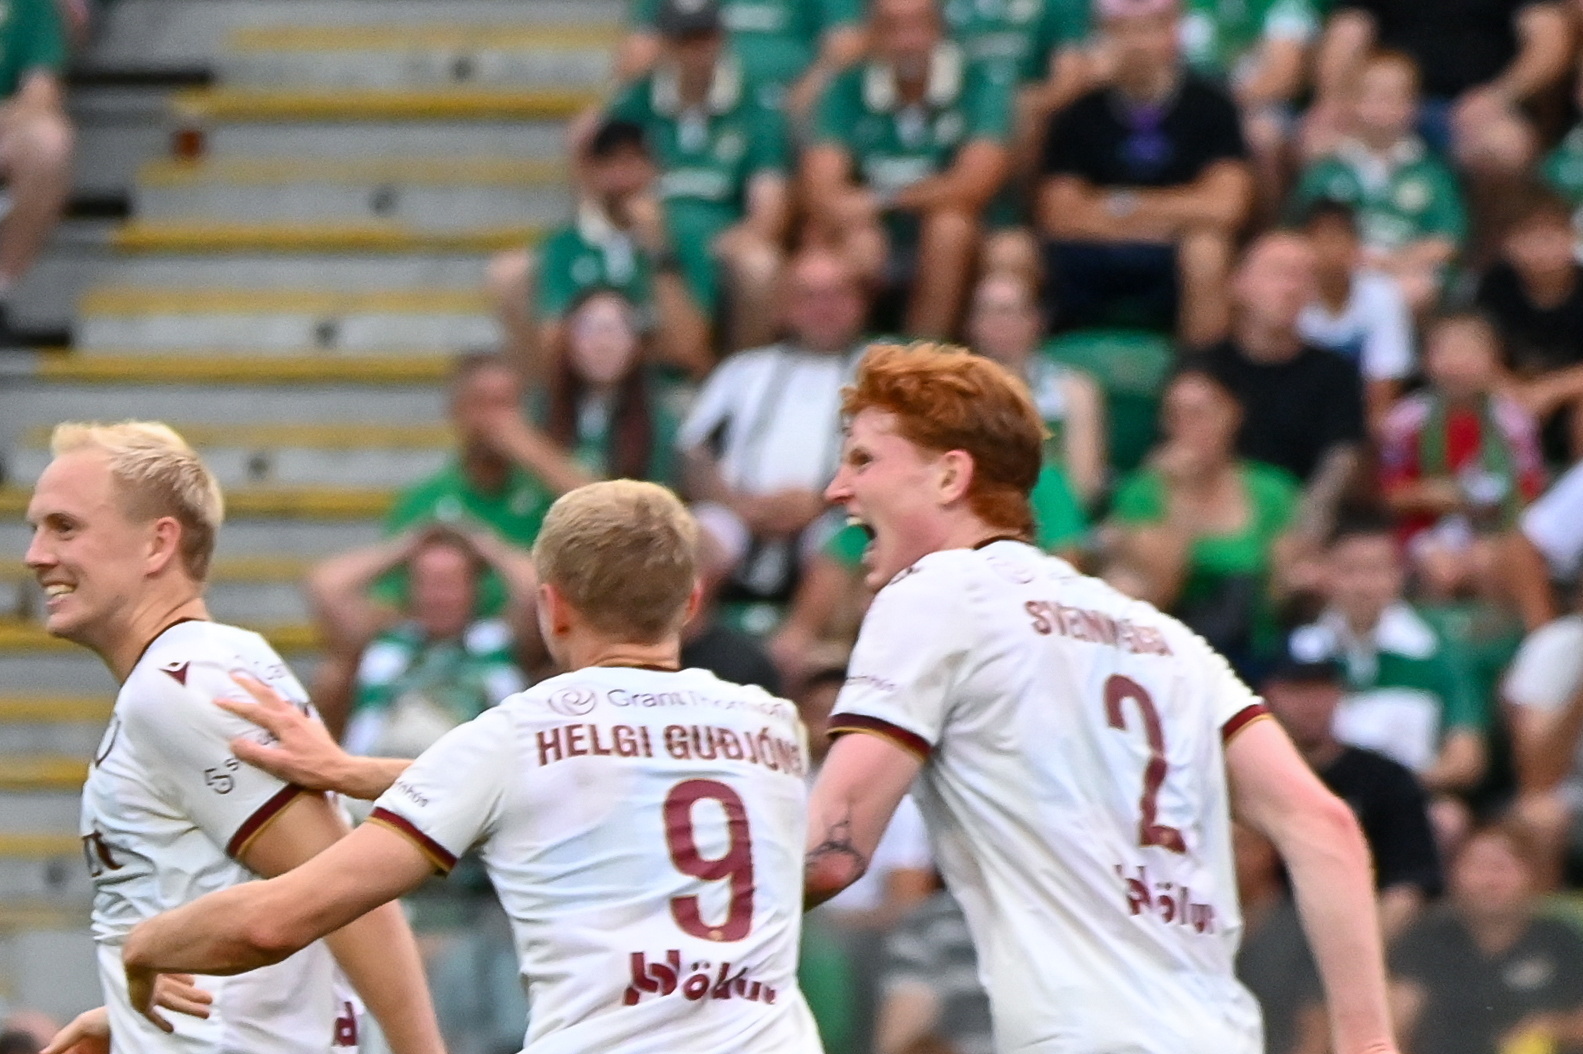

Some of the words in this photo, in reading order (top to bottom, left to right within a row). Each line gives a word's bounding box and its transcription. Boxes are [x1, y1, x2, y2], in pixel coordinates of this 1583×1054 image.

[535, 723, 653, 767] HELGI
[1103, 673, 1187, 855] 2
[662, 778, 756, 943] 9
